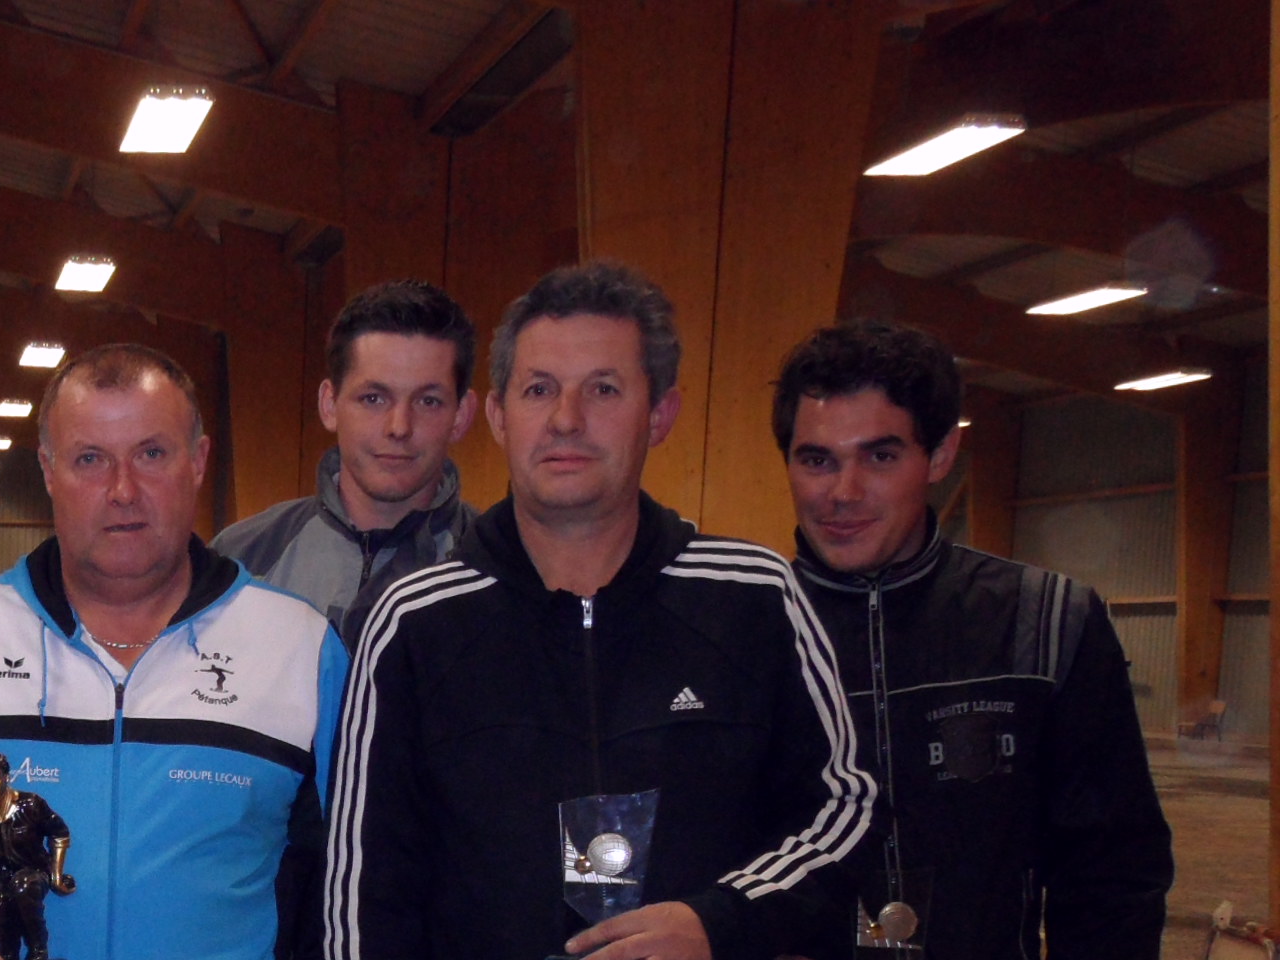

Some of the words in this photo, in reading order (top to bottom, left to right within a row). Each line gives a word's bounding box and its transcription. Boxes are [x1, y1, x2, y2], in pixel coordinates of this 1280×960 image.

[670, 701, 704, 712] adidas
[926, 702, 969, 721] VARSITY
[972, 701, 1016, 713] LEAGUE
[9, 757, 59, 783] Aubert
[169, 769, 213, 780] GROUPE
[215, 772, 252, 786] LECAUX
